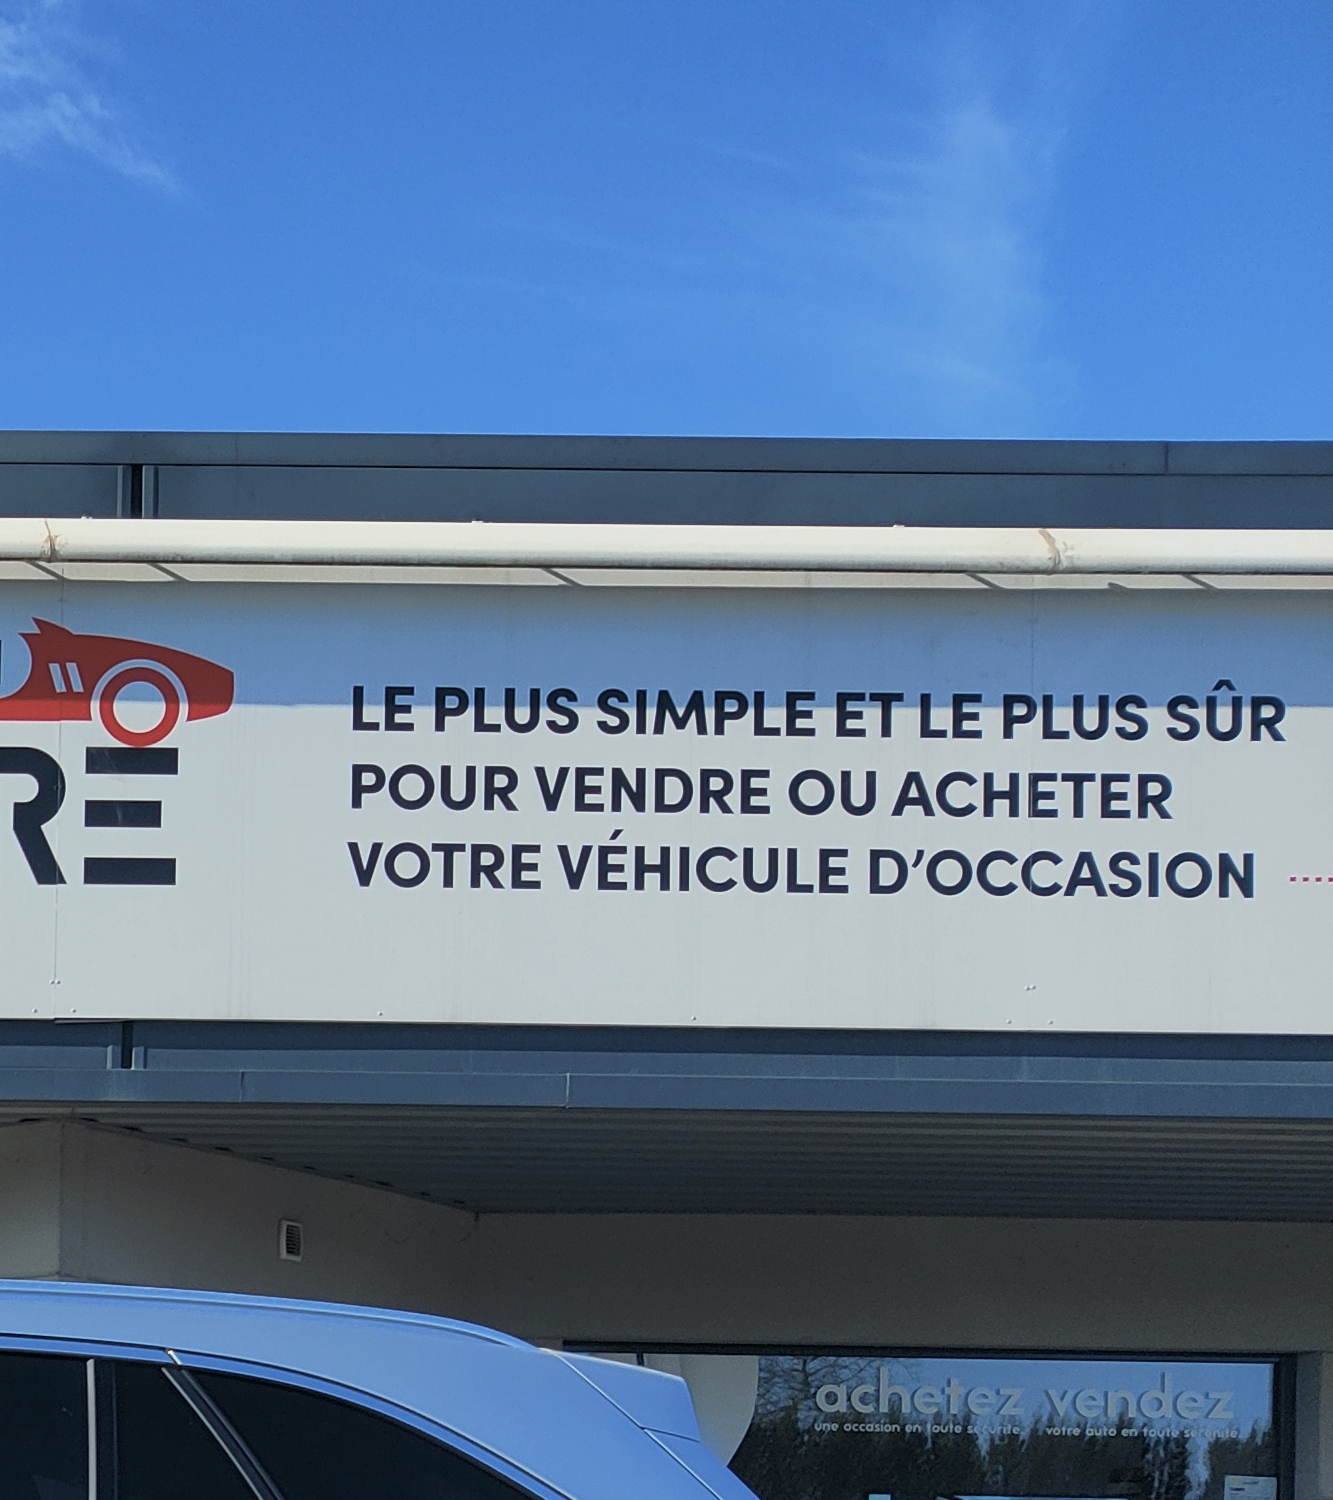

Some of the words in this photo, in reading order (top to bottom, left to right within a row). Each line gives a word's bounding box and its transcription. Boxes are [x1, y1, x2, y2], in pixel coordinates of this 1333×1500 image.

[352, 685, 415, 732] LE
[434, 686, 579, 734] PLUS
[596, 688, 816, 737] SIMPLE
[835, 691, 905, 738] ET
[919, 692, 983, 739] LE
[1002, 693, 1149, 741] PLUS
[1166, 678, 1286, 742] SÛR
[351, 763, 519, 812] POUR
[533, 766, 771, 815] VENDRE
[788, 769, 877, 817] OU
[890, 771, 1173, 820] ACHETER
[346, 841, 542, 890] VOTRE
[556, 828, 849, 894] VÉHICULE
[869, 848, 1255, 899] D'OCCASION
[814, 1367, 1026, 1415] achetez
[1044, 1371, 1233, 1419] vendez
[814, 1422, 839, 1432] une
[843, 1422, 901, 1433] occasion
[905, 1424, 922, 1433] en
[1045, 1426, 1081, 1437] votre
[1085, 1426, 1117, 1437] auto
[1121, 1427, 1138, 1437] en
[1142, 1426, 1180, 1438] toute
